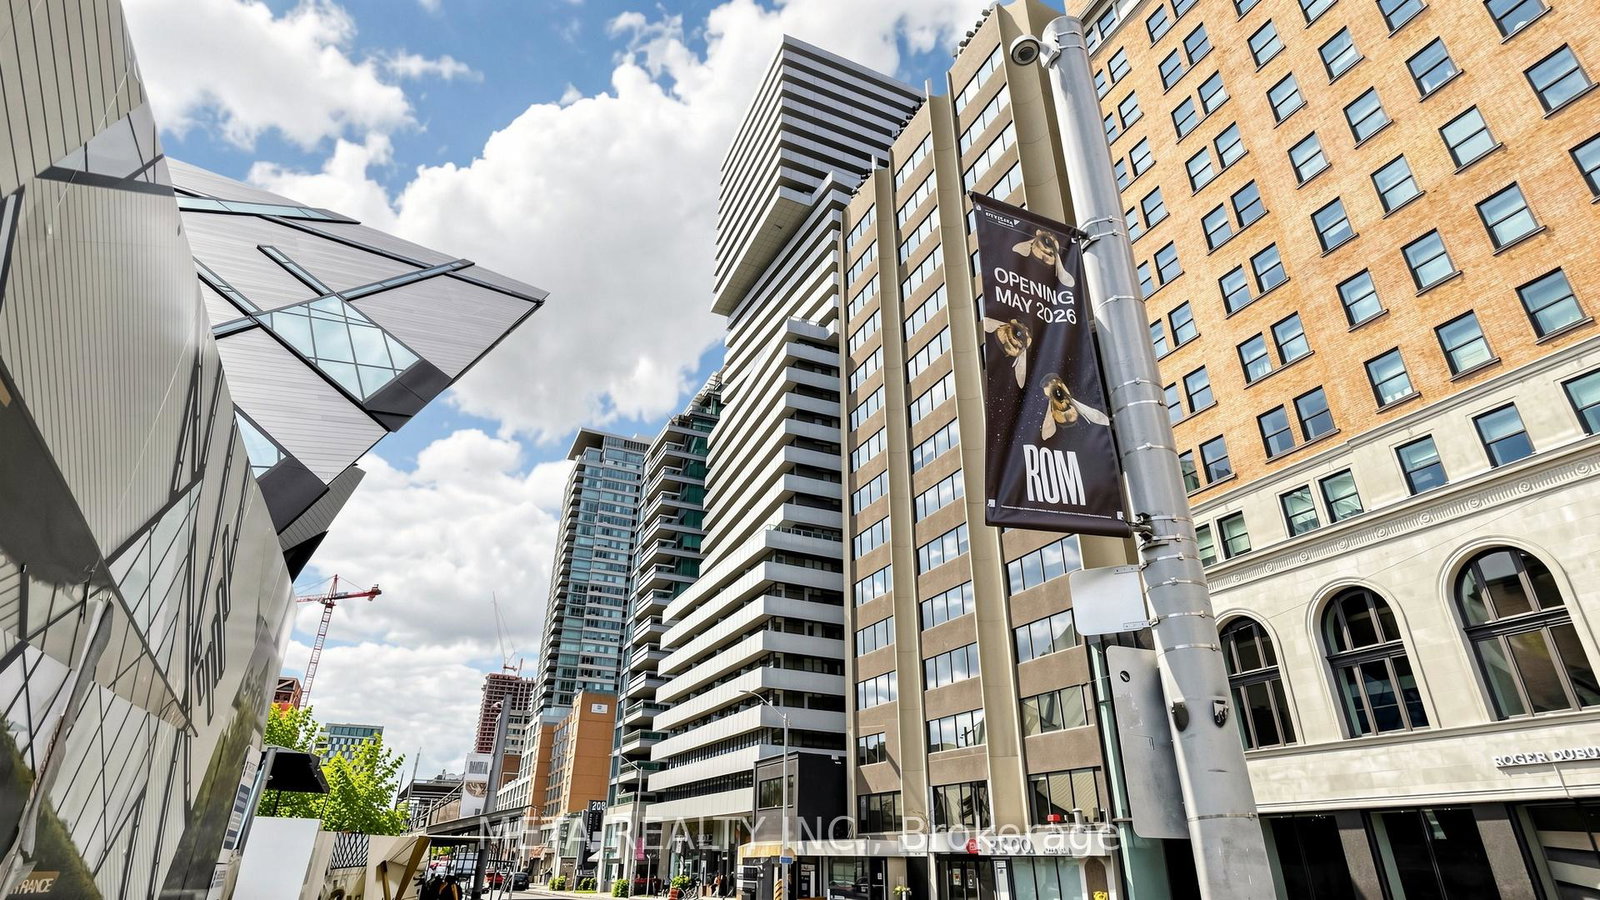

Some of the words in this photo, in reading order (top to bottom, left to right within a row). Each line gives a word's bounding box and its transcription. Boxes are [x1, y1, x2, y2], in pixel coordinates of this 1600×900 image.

[994, 267, 1075, 305] OPENING
[995, 286, 1033, 314] MAY
[1036, 302, 1077, 325] 2026
[1023, 444, 1086, 507] ROM
[1493, 752, 1551, 767] ROGER
[592, 801, 606, 811] 208
